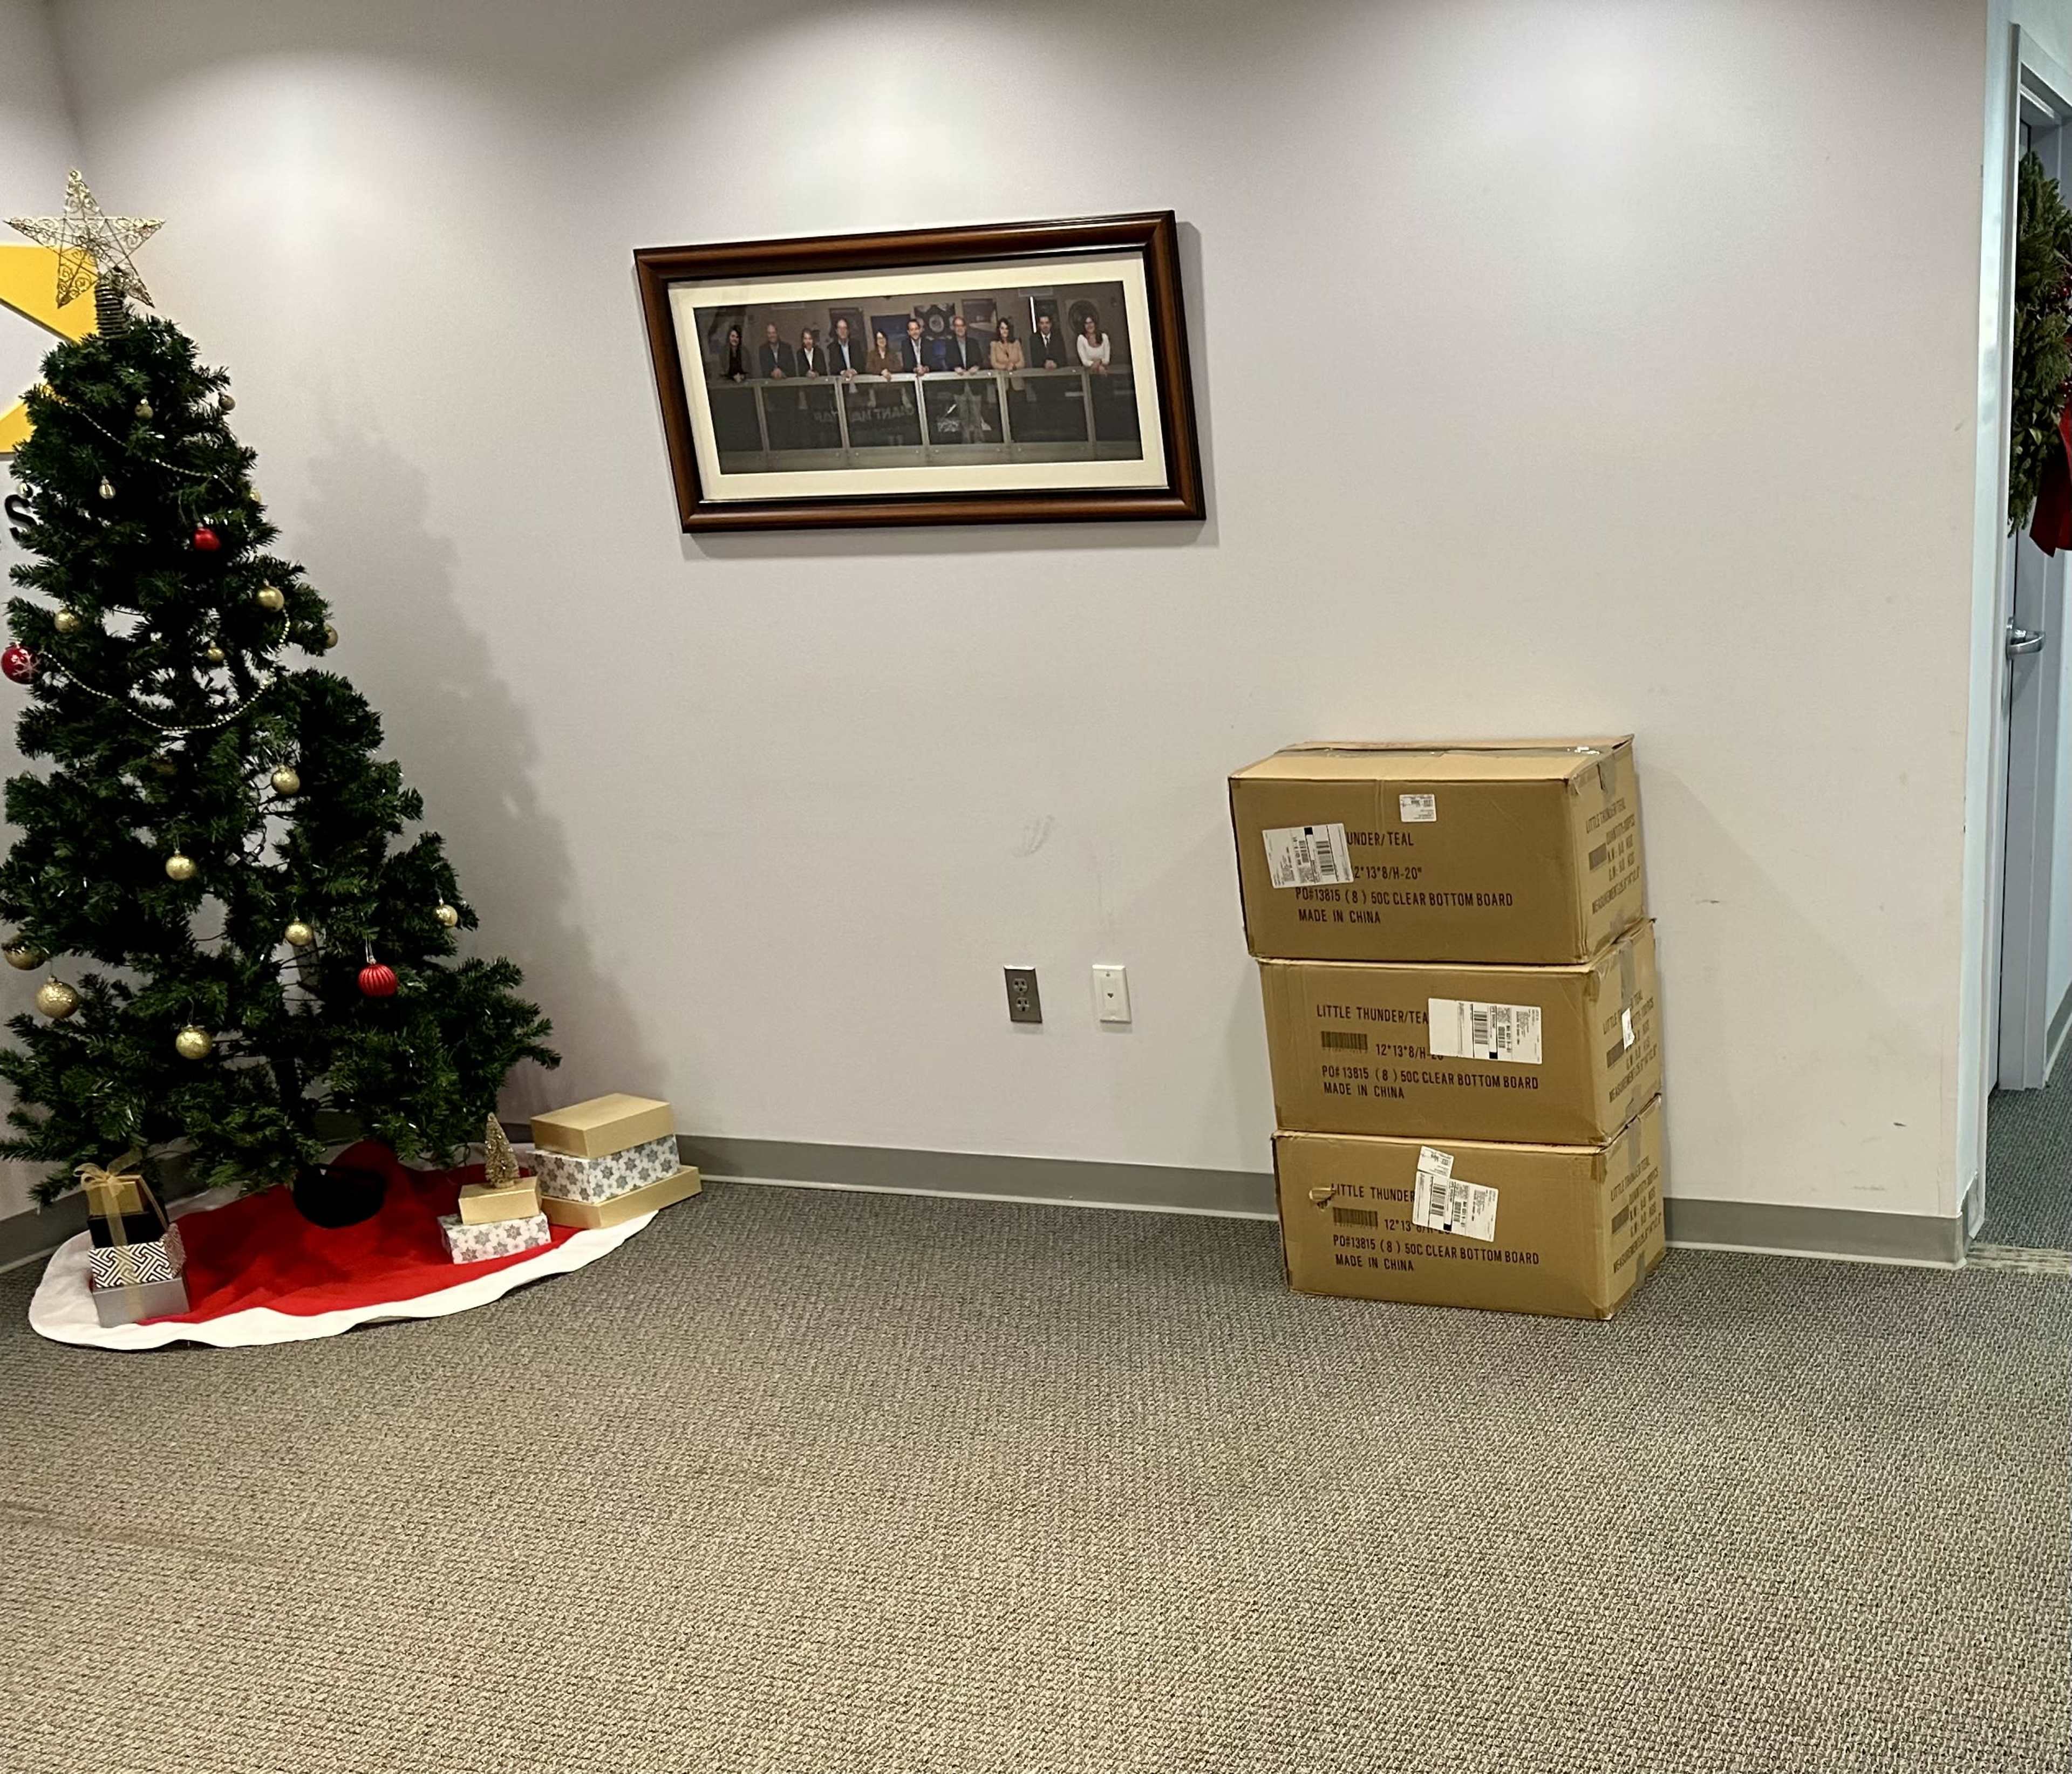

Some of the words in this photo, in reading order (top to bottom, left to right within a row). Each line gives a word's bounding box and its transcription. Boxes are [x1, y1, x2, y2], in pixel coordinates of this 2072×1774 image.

[1393, 892, 1426, 905] CLEAR
[1429, 892, 1474, 906] BOTTOM
[1476, 893, 1513, 906] BOARD
[1298, 909, 1327, 922] MADE
[1333, 909, 1344, 923] IN
[1349, 910, 1381, 924] CHINA
[1317, 1004, 1351, 1019] LITTLE
[1356, 1007, 1429, 1025] THUNDER/TEA
[1422, 1071, 1454, 1086] CLEAR
[1457, 1074, 1501, 1087] BOTTOM
[1503, 1076, 1538, 1089] BOARD
[1324, 1082, 1351, 1095] MADE
[1358, 1084, 1368, 1096] IN
[1374, 1086, 1405, 1098] CHINA
[1335, 1253, 1363, 1267] MADE
[1368, 1256, 1378, 1268] IN
[1384, 1258, 1414, 1271] CHINA
[1426, 1244, 1456, 1259] CLEAR
[1460, 1247, 1502, 1261] BOTTOM
[1505, 1251, 1539, 1265] BOARD
